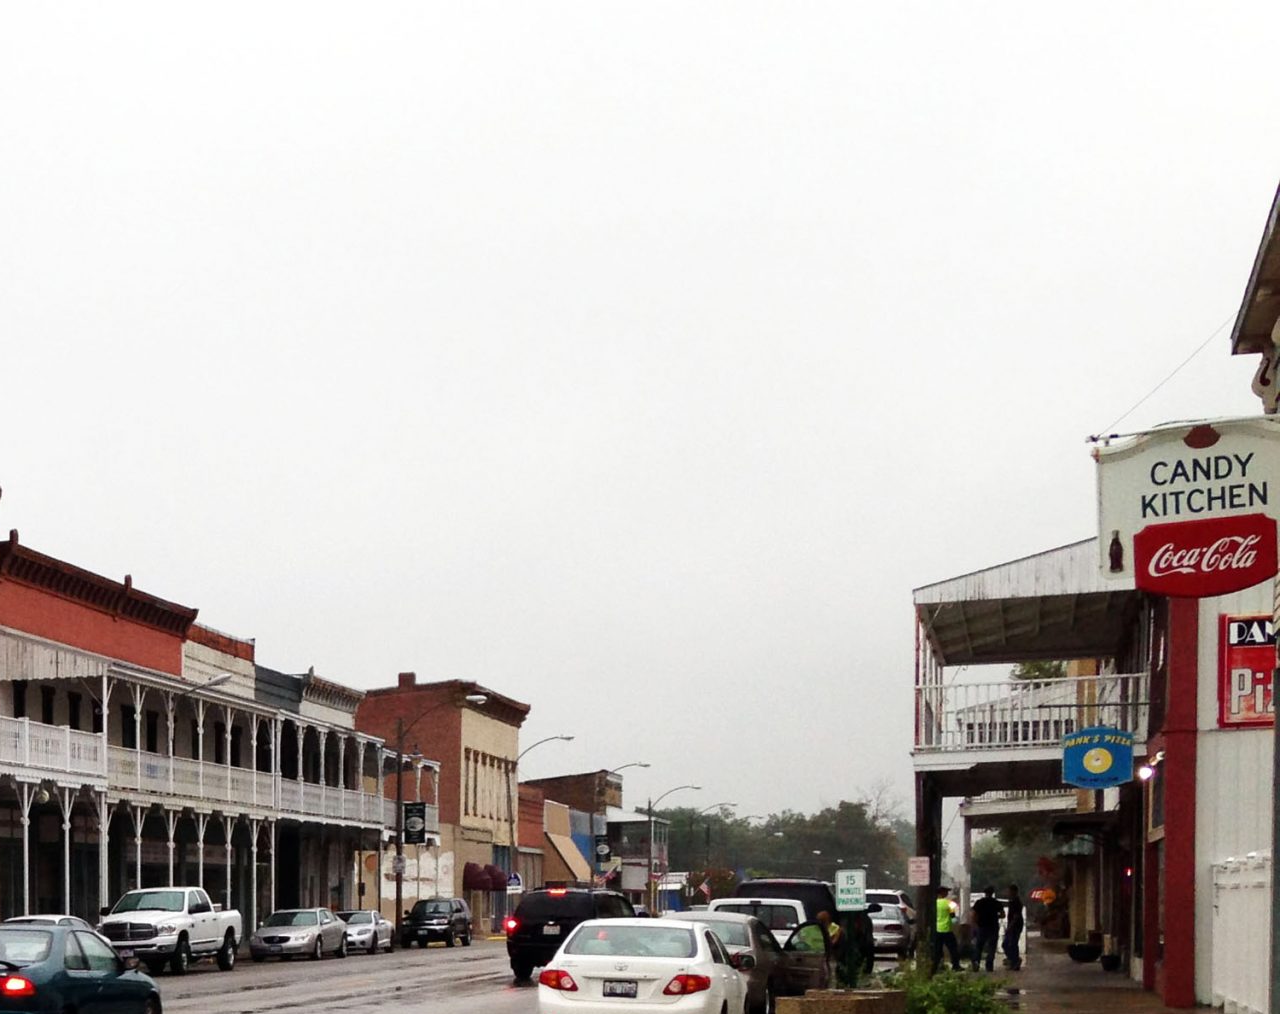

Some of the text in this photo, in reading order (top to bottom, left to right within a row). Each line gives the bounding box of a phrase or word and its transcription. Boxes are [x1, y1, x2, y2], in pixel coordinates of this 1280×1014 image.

[1150, 452, 1255, 486] CANDY
[1141, 481, 1268, 518] KITCHEN
[1148, 534, 1262, 577] Coca-Cola
[846, 874, 856, 885] 15
[838, 897, 864, 906] PARKING
[840, 887, 861, 895] MINUTE
